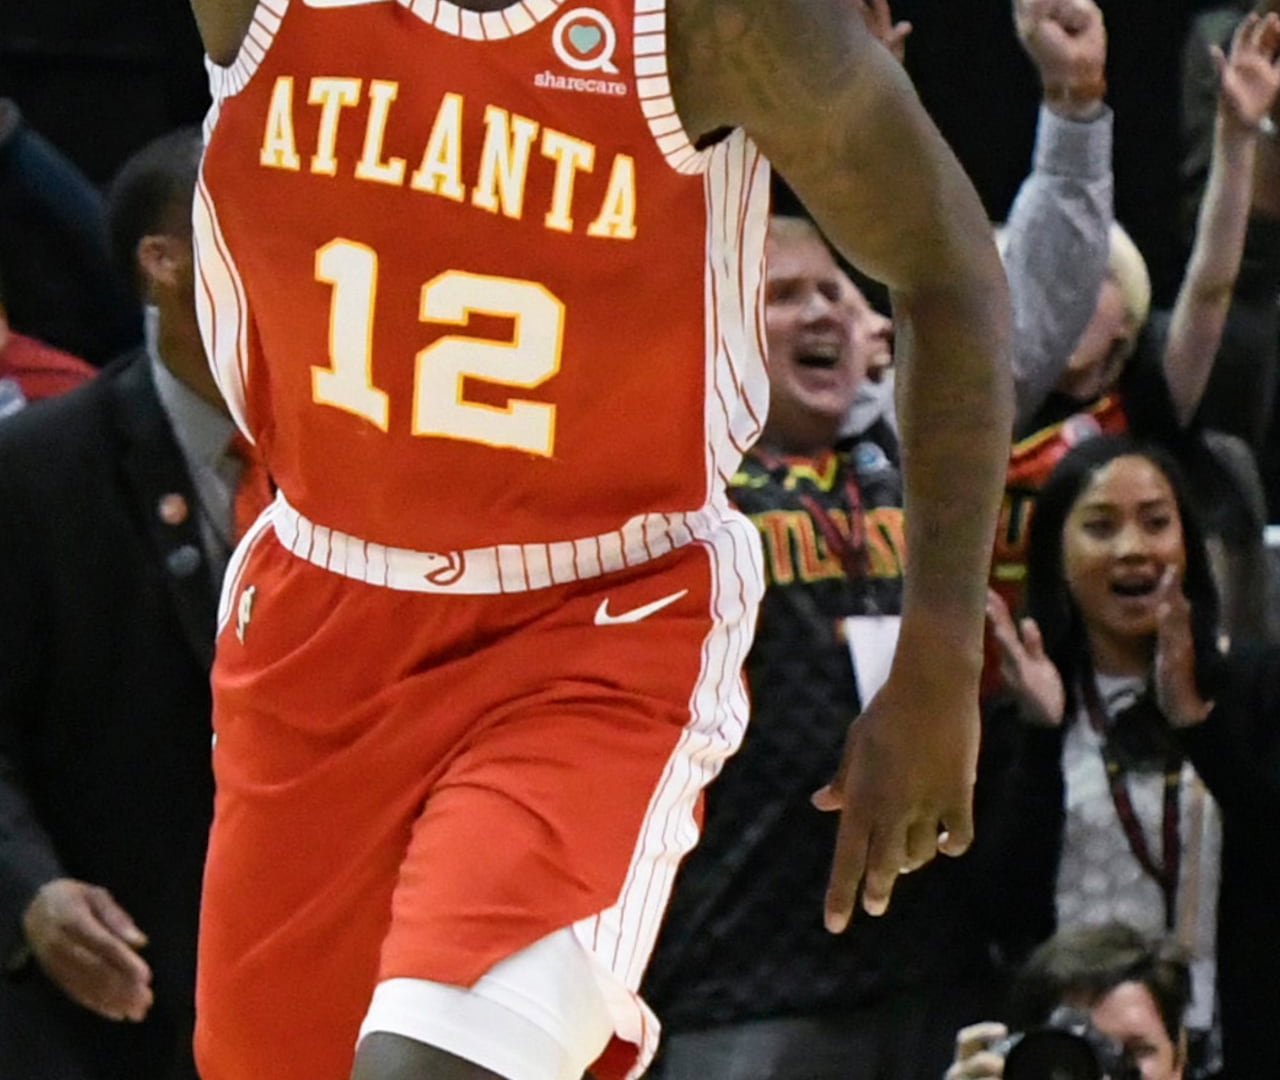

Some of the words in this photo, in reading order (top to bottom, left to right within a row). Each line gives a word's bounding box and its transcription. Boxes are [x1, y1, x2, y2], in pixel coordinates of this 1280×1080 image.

[259, 75, 638, 241] ATLANTA
[533, 70, 627, 96] sharecare
[310, 237, 567, 459] 12
